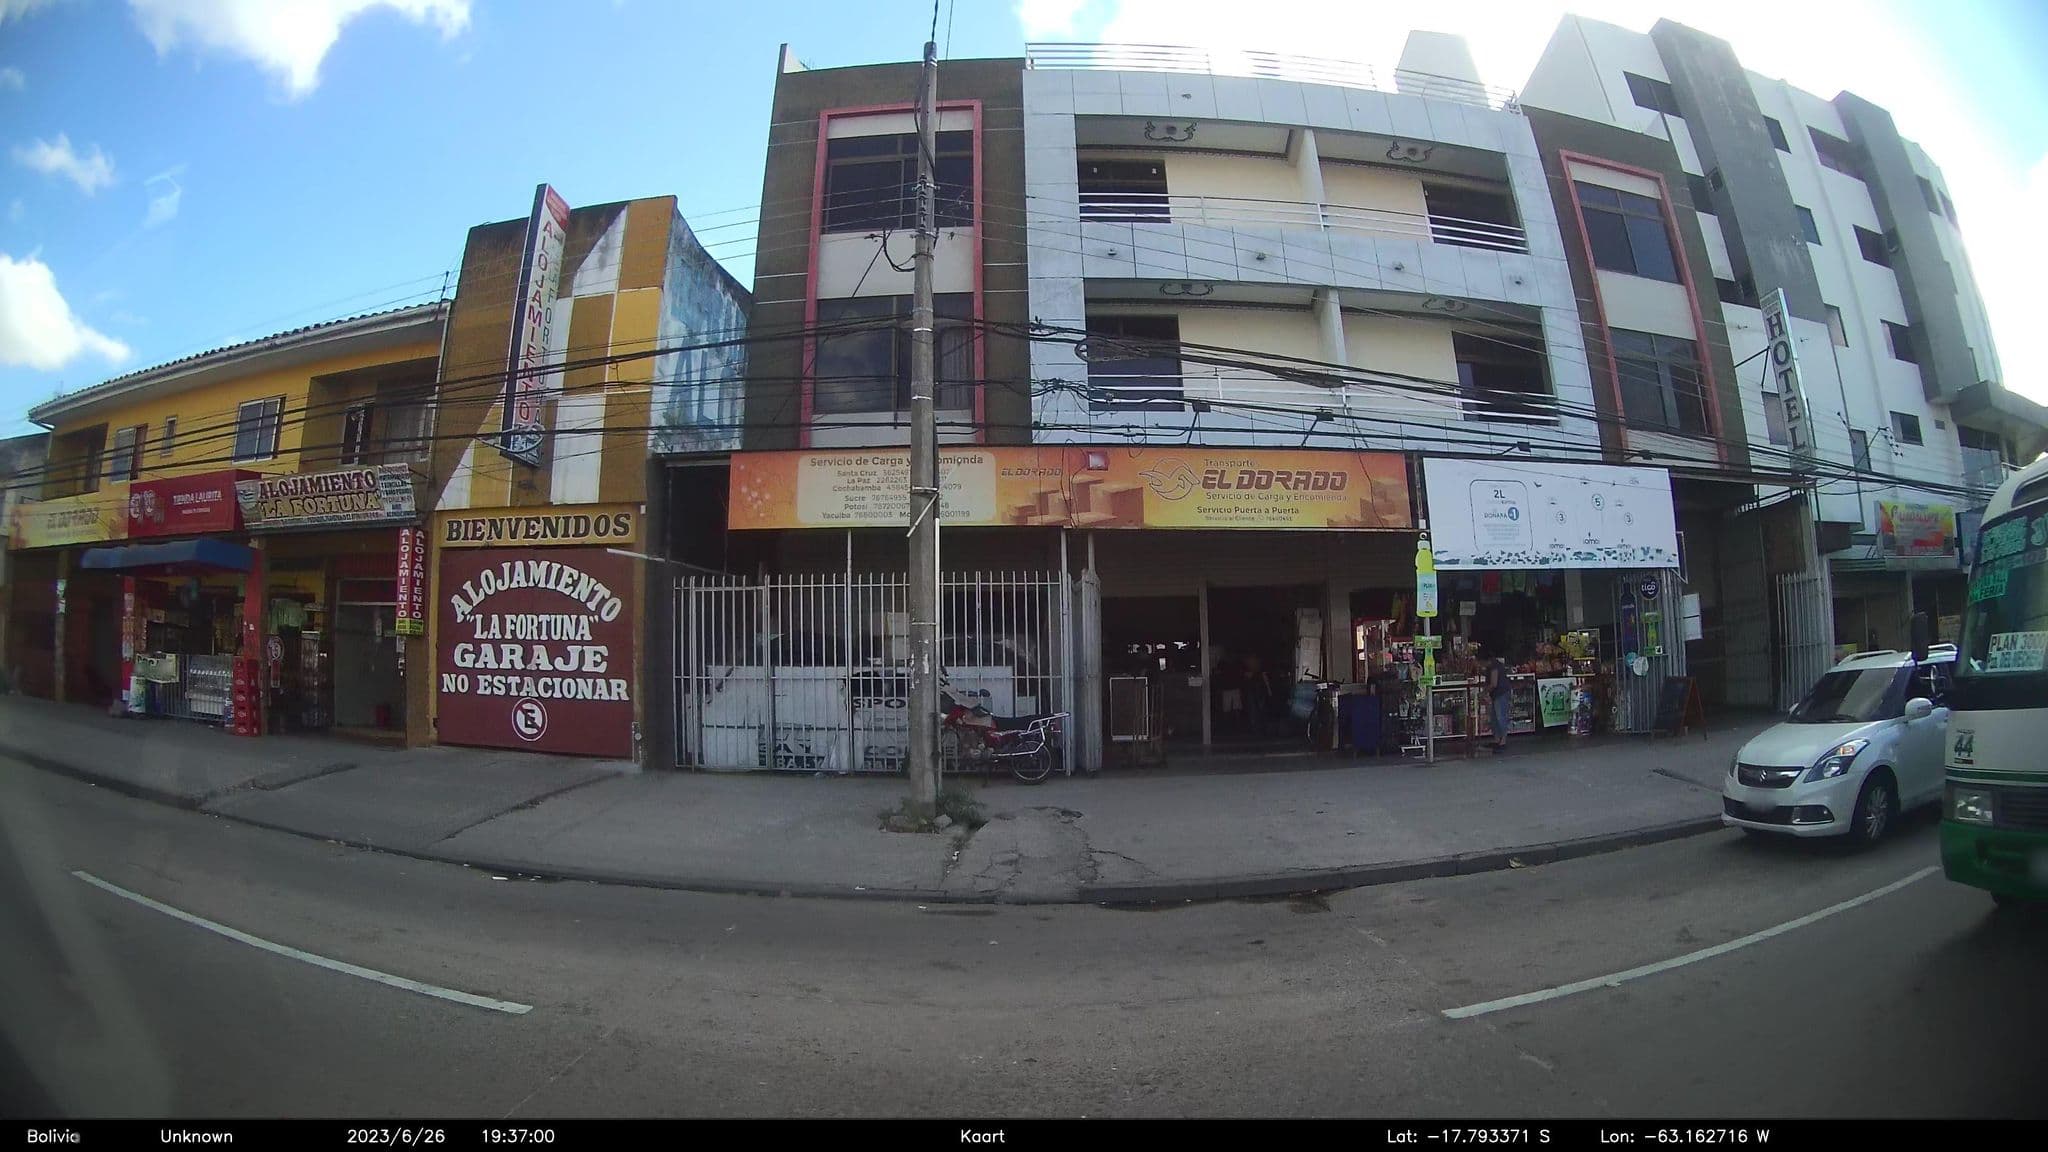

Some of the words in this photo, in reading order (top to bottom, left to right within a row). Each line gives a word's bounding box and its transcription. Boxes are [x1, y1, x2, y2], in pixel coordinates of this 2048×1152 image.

[1766, 312, 1806, 452] HOTEL
[810, 456, 853, 467] Servicio
[855, 456, 870, 466] de
[872, 456, 904, 467] Carga
[258, 469, 378, 500] ALOJAMIENTO
[832, 484, 882, 492] Cochabamba
[1201, 469, 1232, 490] EL
[1236, 469, 1348, 491] DORADO
[1493, 489, 1506, 499] 2L
[1196, 506, 1232, 514] Servicio
[1234, 506, 1263, 514] Puerta
[1272, 506, 1300, 515] Puerta
[1206, 491, 1242, 501] Servicio
[1257, 492, 1285, 502] Carga
[446, 512, 632, 542] BIENVENIDOS
[398, 529, 410, 618] ALOJAMIENTO
[412, 530, 425, 619] ALOJAMIENTO
[451, 560, 622, 623] ALOJAMIENTO
[466, 614, 502, 641] "LA
[505, 613, 599, 642] FORTUNA"
[453, 643, 609, 673] GARAJE
[1989, 634, 2017, 653] PLAN
[442, 673, 469, 693] NO
[476, 675, 630, 702] ESTACIONAR
[1954, 734, 1974, 757] 44
